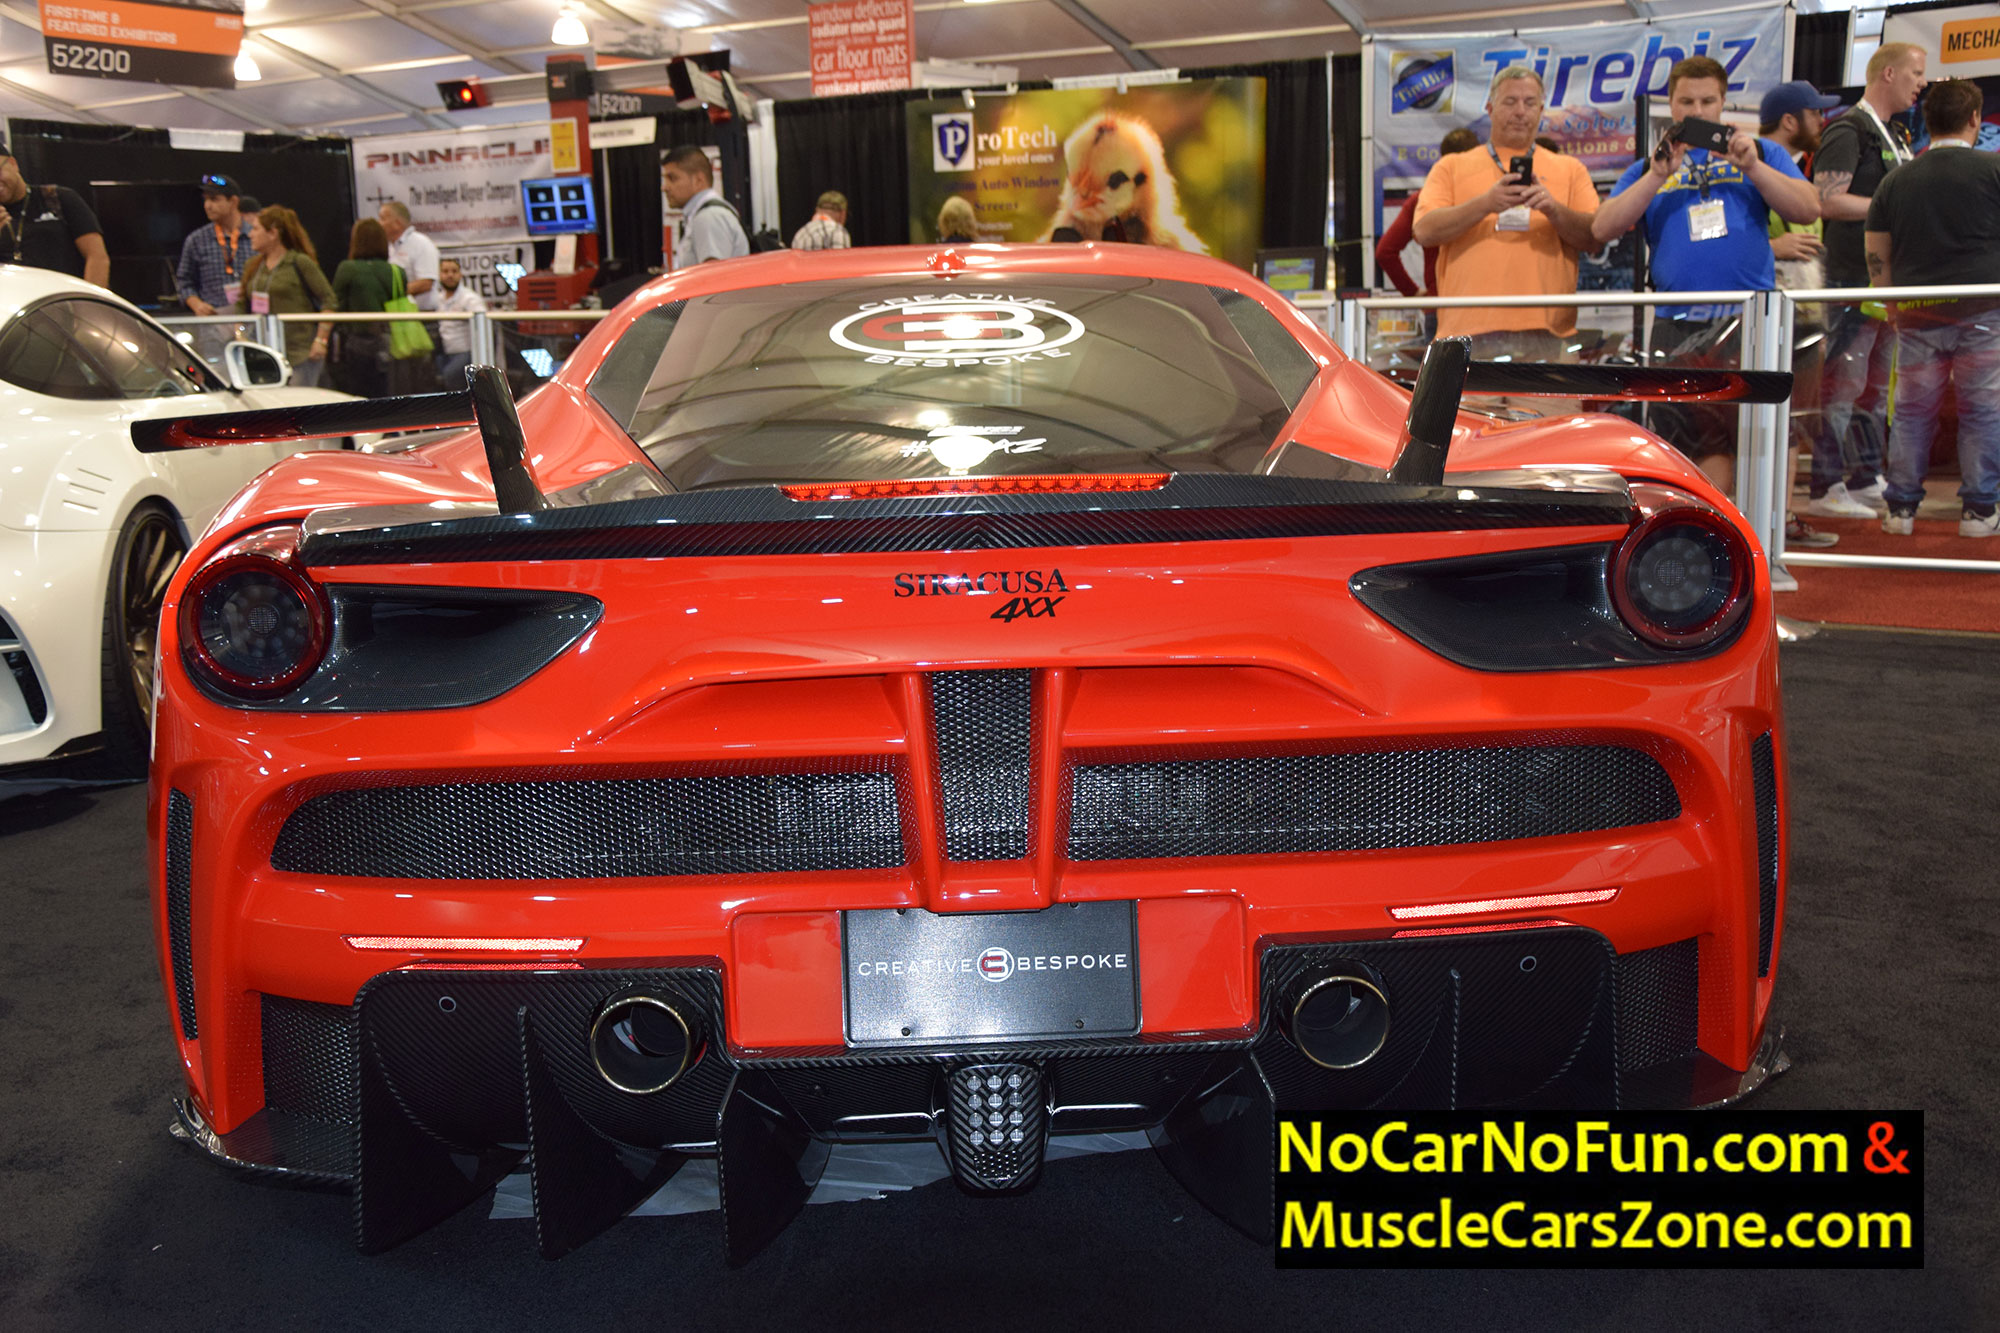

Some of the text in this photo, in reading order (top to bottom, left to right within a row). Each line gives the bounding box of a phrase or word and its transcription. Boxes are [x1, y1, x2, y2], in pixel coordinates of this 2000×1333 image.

[44, 4, 109, 24] FIRST-TIME
[812, 4, 852, 24] window
[46, 17, 177, 45] FEATURED EXHIBITORS
[812, 14, 906, 38] radiator mesh guard
[52, 43, 131, 74] 52200
[813, 43, 907, 73] car floor mats
[977, 152, 1054, 169] your loved ones
[981, 178, 1008, 191] Auto
[1011, 175, 1060, 189] Window
[859, 293, 1057, 311] CREATIVE
[864, 348, 1071, 367] BESPOKE
[894, 568, 1070, 597] SIRACUSA
[858, 958, 973, 976] CREATIVE
[1017, 953, 1128, 971] BESPOKE
